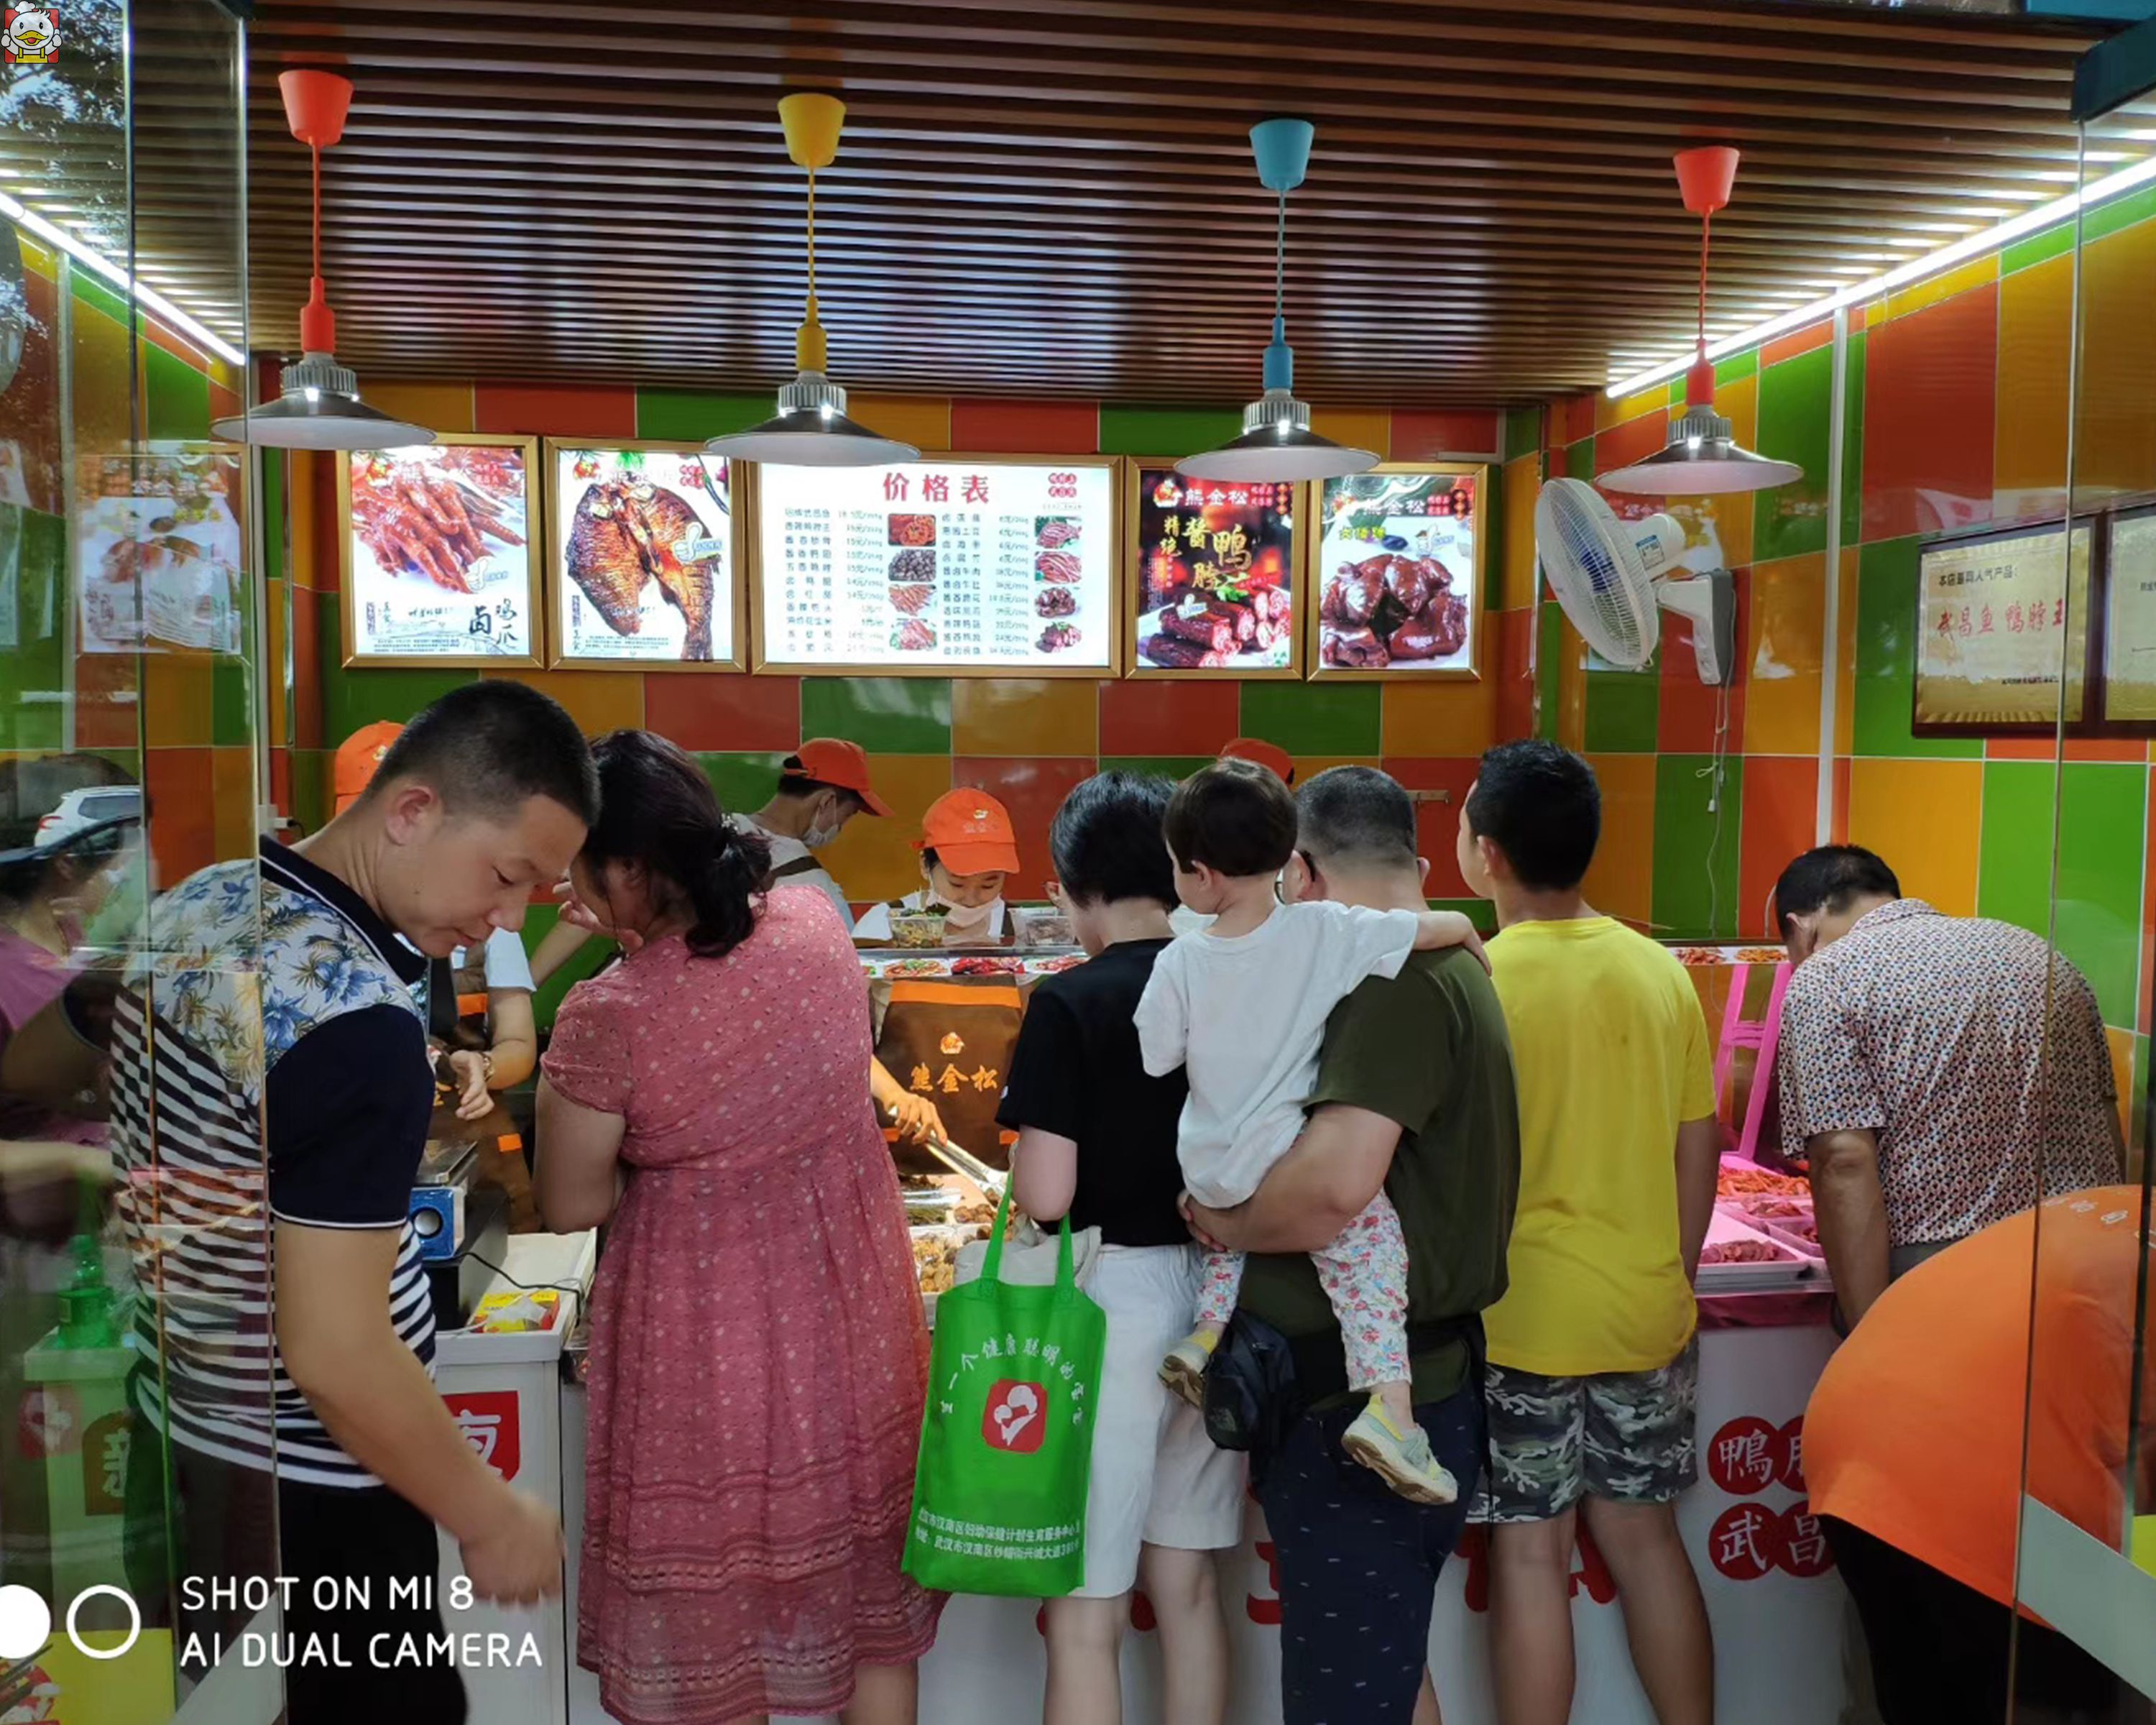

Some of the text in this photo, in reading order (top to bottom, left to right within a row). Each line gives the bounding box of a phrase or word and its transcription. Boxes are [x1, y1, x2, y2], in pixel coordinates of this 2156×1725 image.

[883, 472, 990, 504] 价格表
[1184, 487, 1249, 507] 熊金松
[909, 1062, 998, 1094] 熊金松
[1718, 1428, 1805, 1484] 鴨
[1718, 1509, 1827, 1570] 武昌
